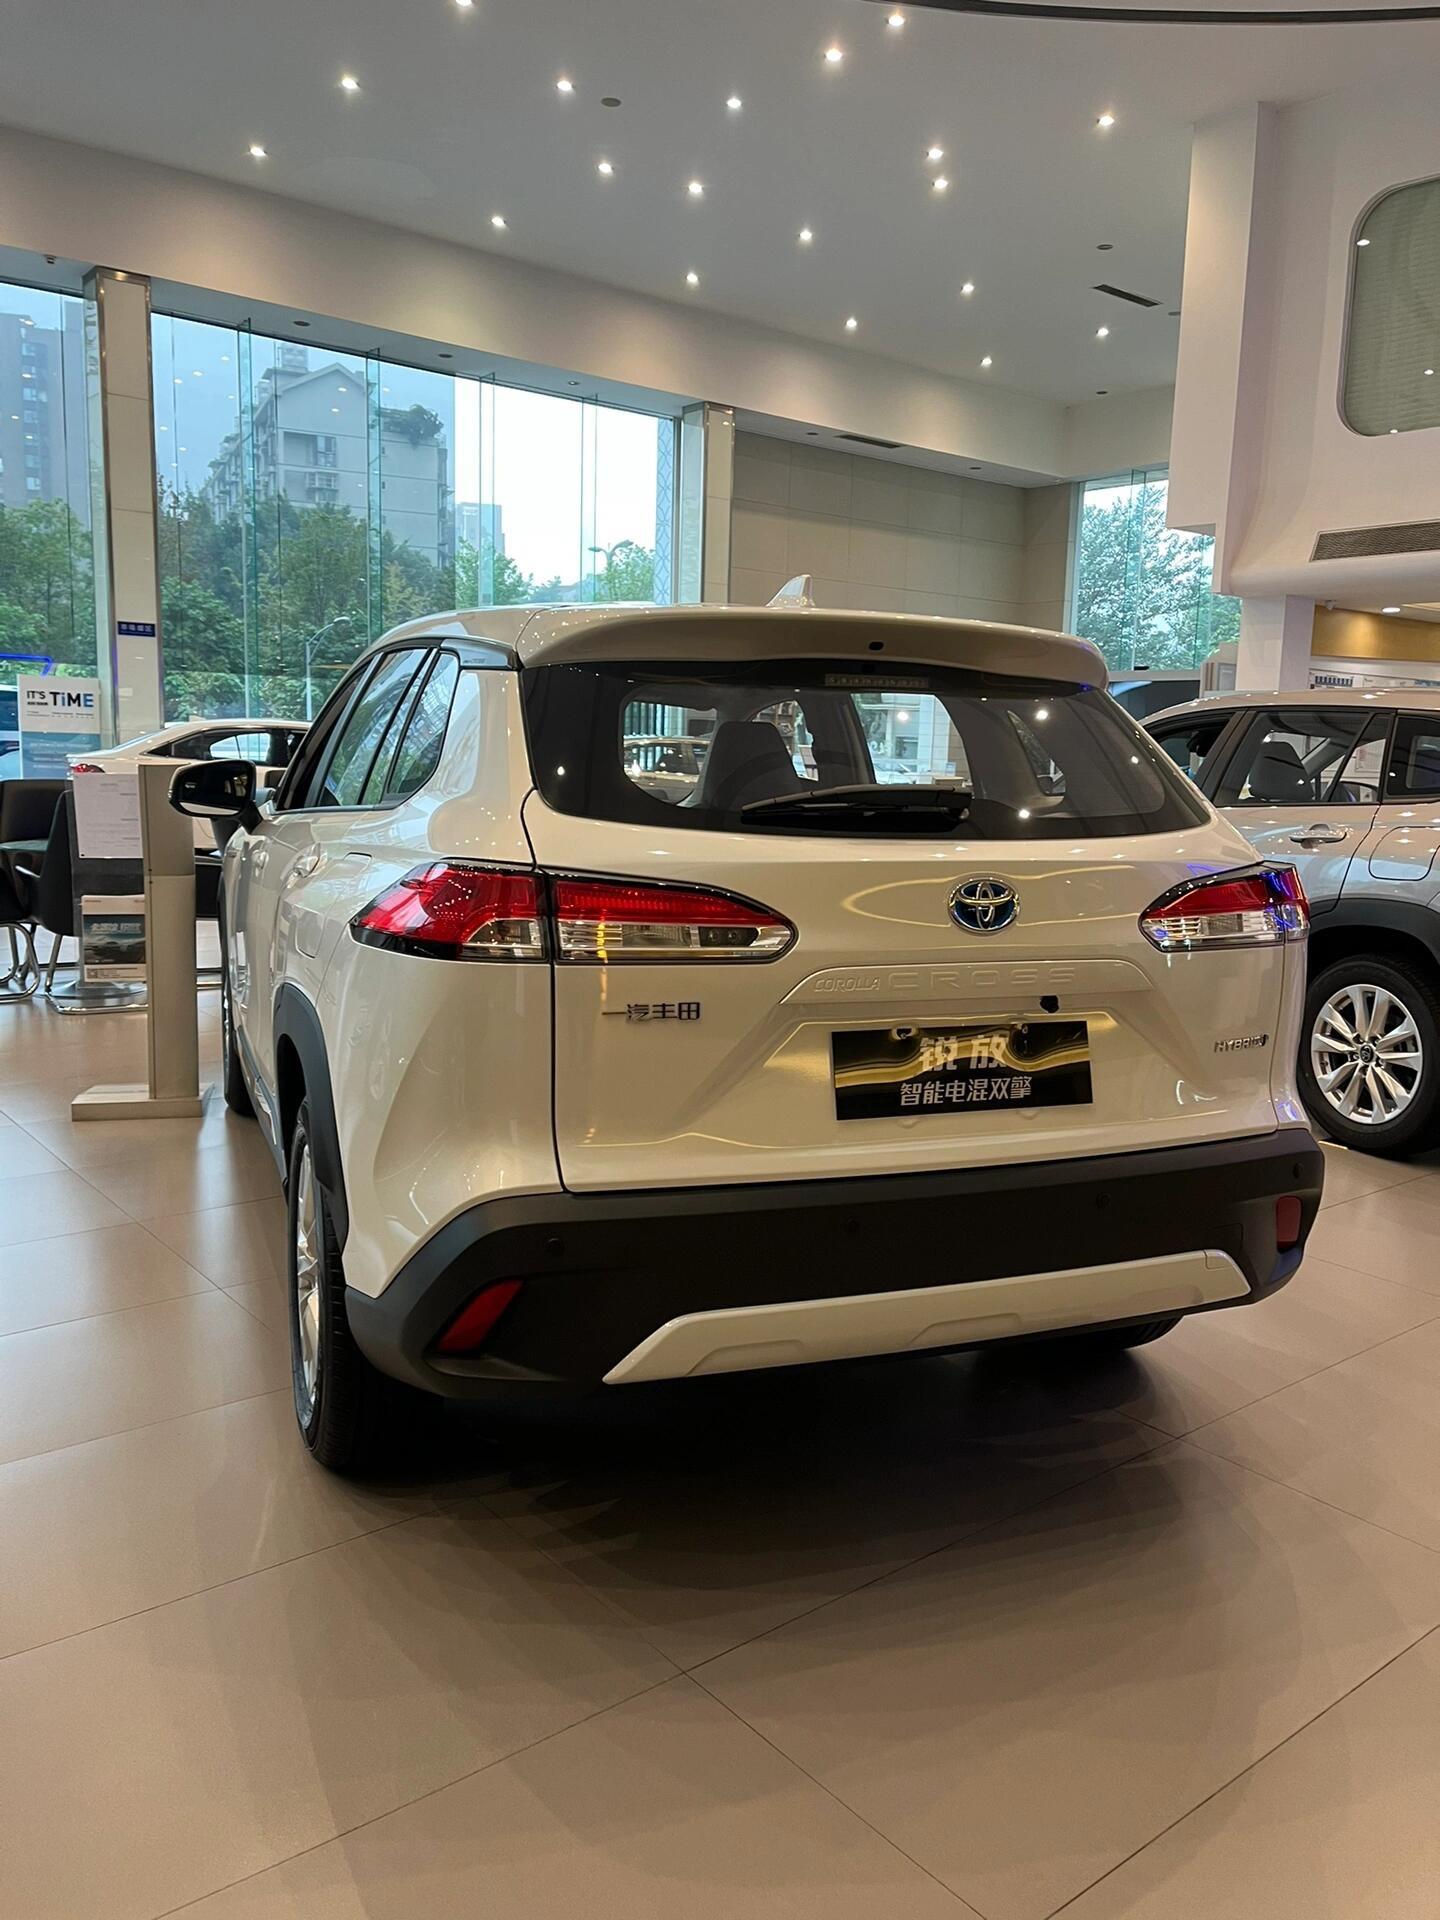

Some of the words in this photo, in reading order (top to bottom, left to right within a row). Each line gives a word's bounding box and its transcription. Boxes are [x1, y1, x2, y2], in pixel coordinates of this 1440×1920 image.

[26, 690, 46, 700] IT'S
[813, 977, 881, 993] COROLLA
[888, 967, 1076, 989] CROSS
[601, 1001, 700, 1021] 一汽丰田
[918, 1035, 1009, 1072] 锐放
[1213, 1034, 1267, 1052] HYBRID
[899, 1075, 1033, 1107] 智能电混双擎
